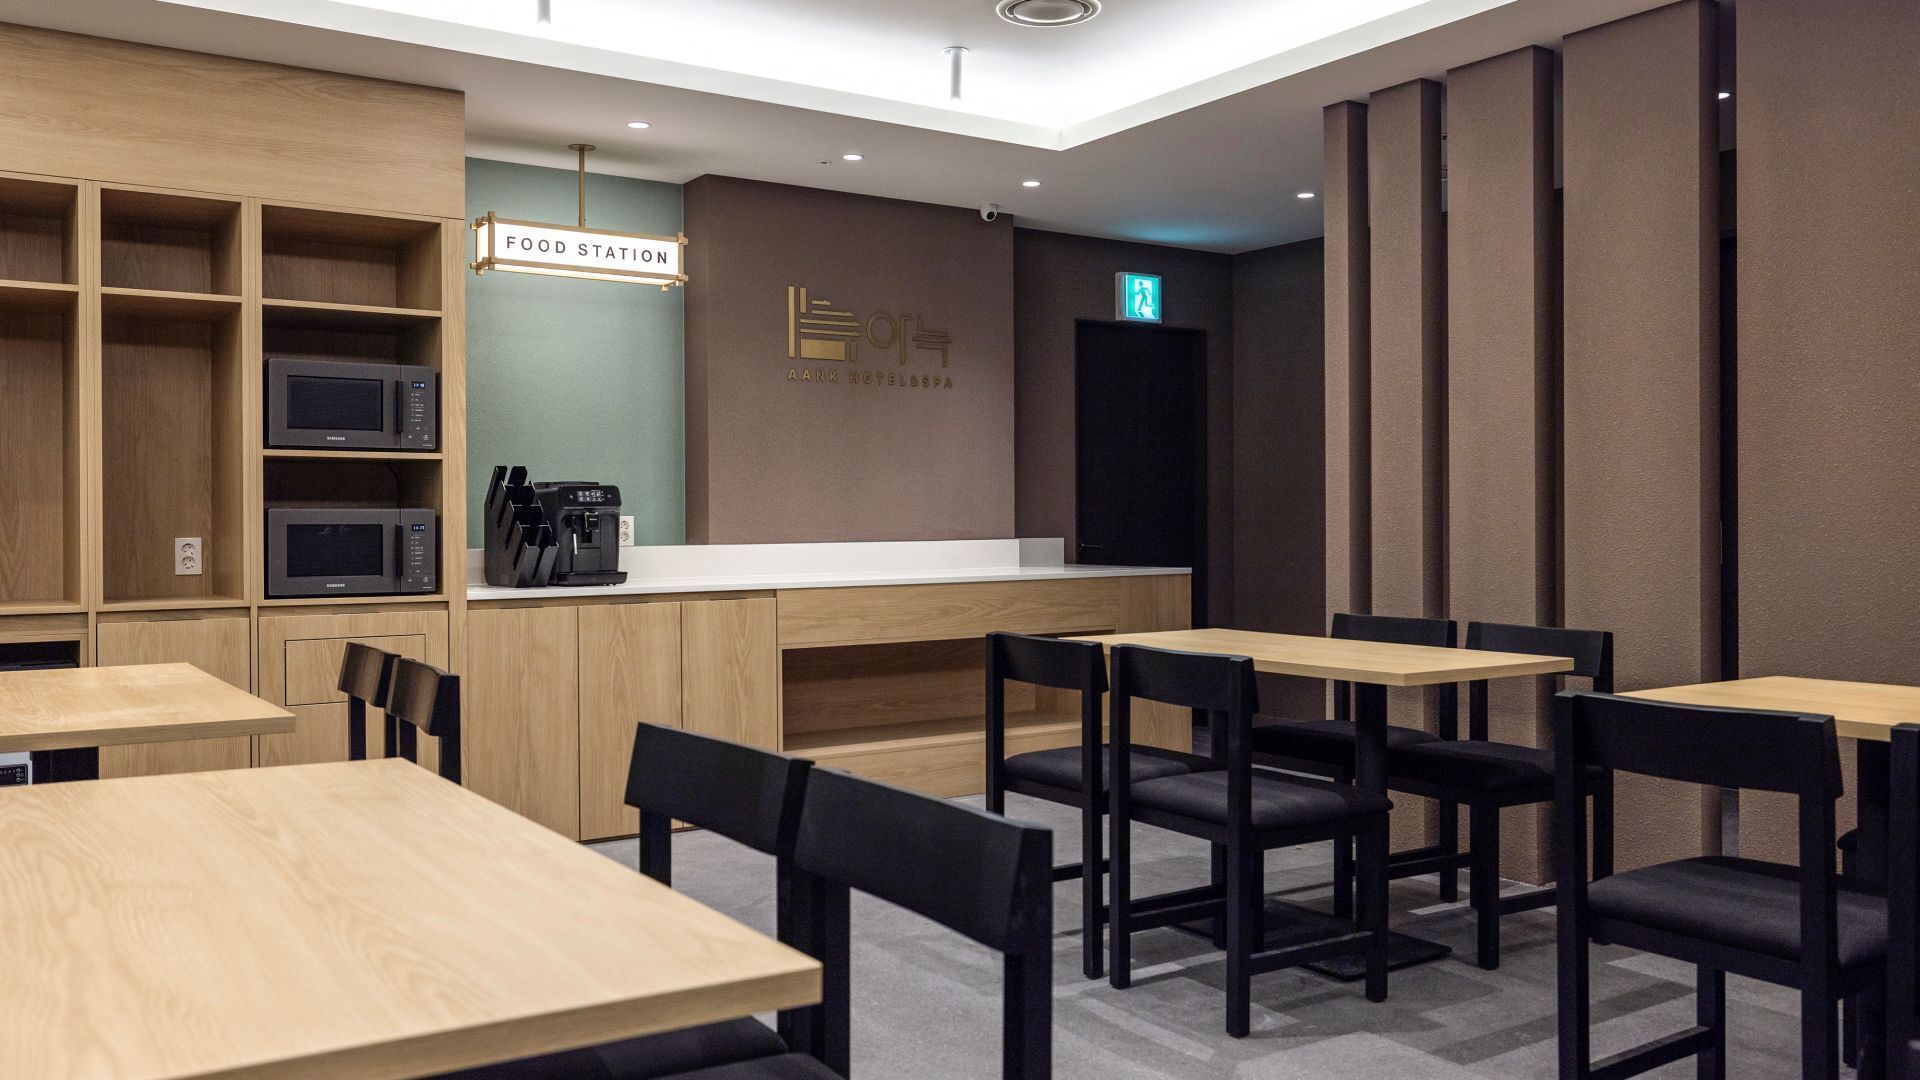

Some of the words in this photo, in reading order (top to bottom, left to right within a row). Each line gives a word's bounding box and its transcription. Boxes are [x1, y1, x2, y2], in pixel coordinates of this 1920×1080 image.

[506, 235, 567, 255] FOOD
[577, 243, 668, 264] STATION
[787, 368, 839, 384] AANK
[849, 371, 953, 390] HOTEL&SPA
